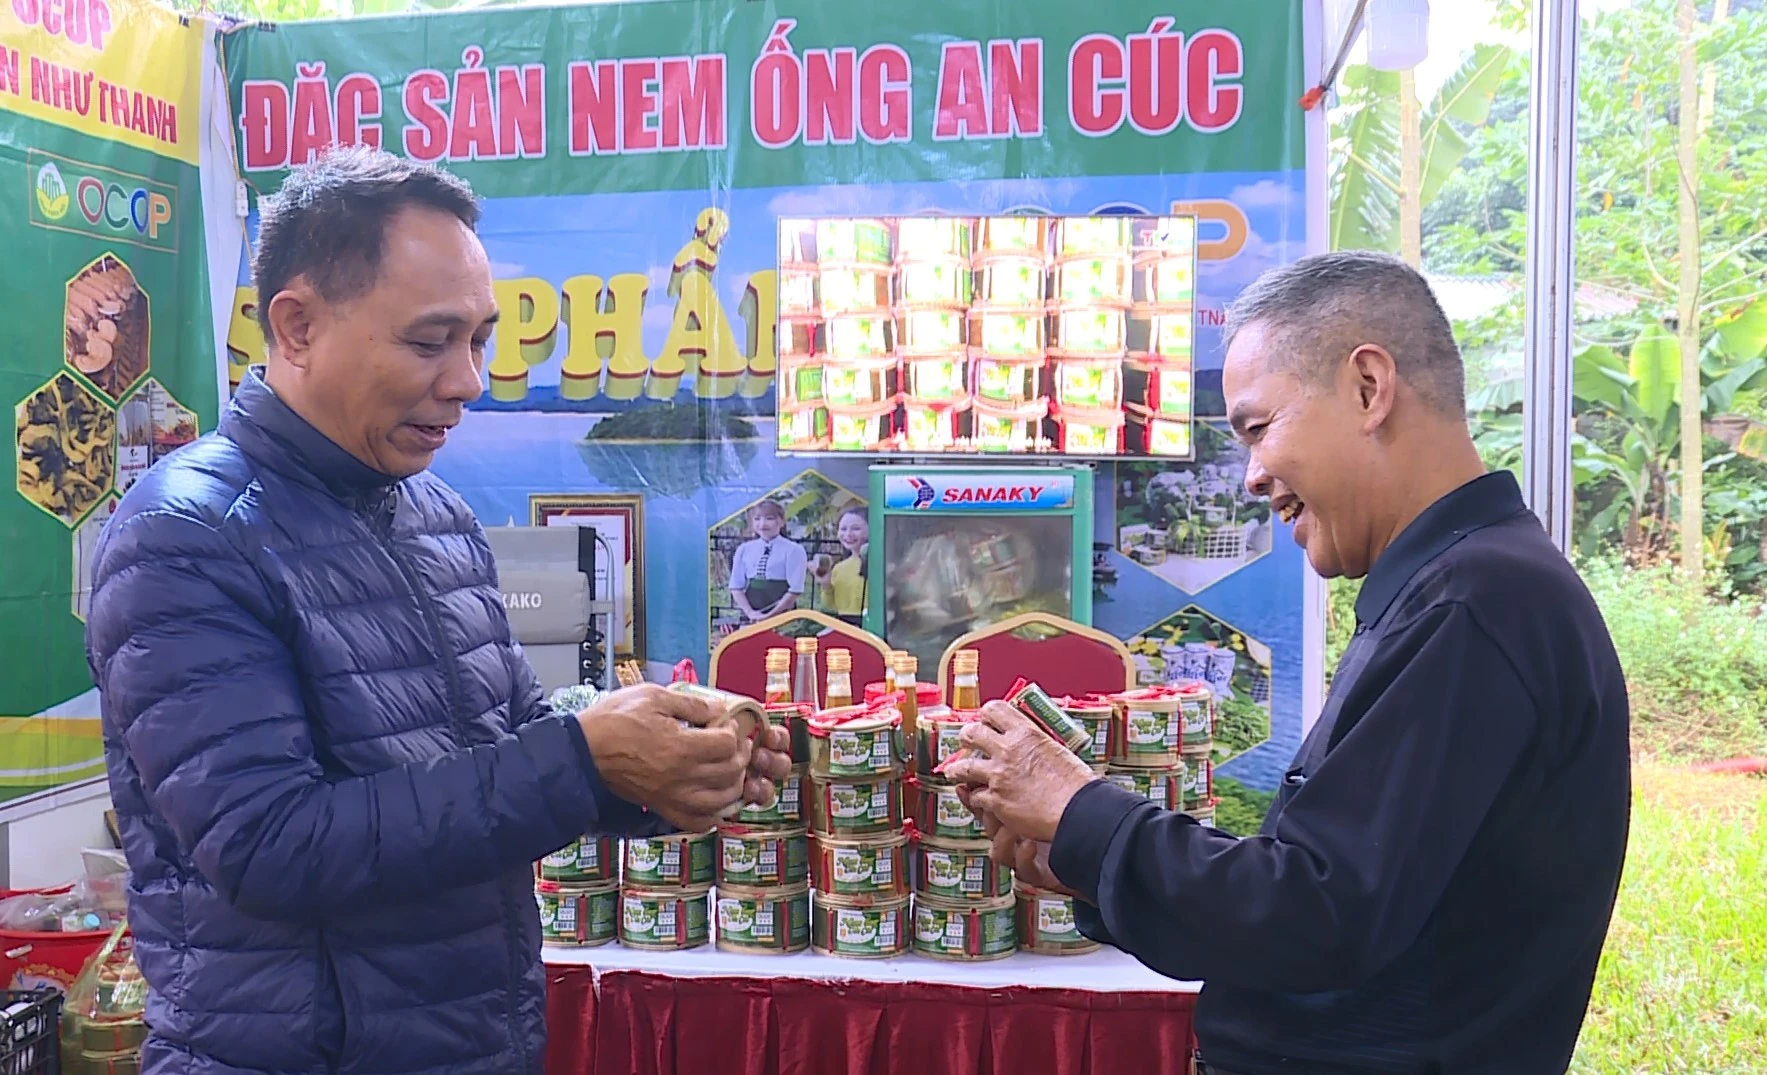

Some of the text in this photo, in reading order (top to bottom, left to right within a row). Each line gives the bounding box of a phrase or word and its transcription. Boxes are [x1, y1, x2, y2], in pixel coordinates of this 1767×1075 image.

[31, 56, 93, 117] NHƯ
[98, 80, 177, 144] THANH
[405, 49, 542, 159] SẢN
[571, 58, 723, 152] NEM
[755, 23, 910, 144] ỐNG
[935, 42, 1041, 137] AN
[1070, 22, 1240, 132] CÚC
[78, 177, 172, 239] OCOP
[487, 207, 776, 402] PHẨ
[942, 487, 1044, 503] SANAKY
